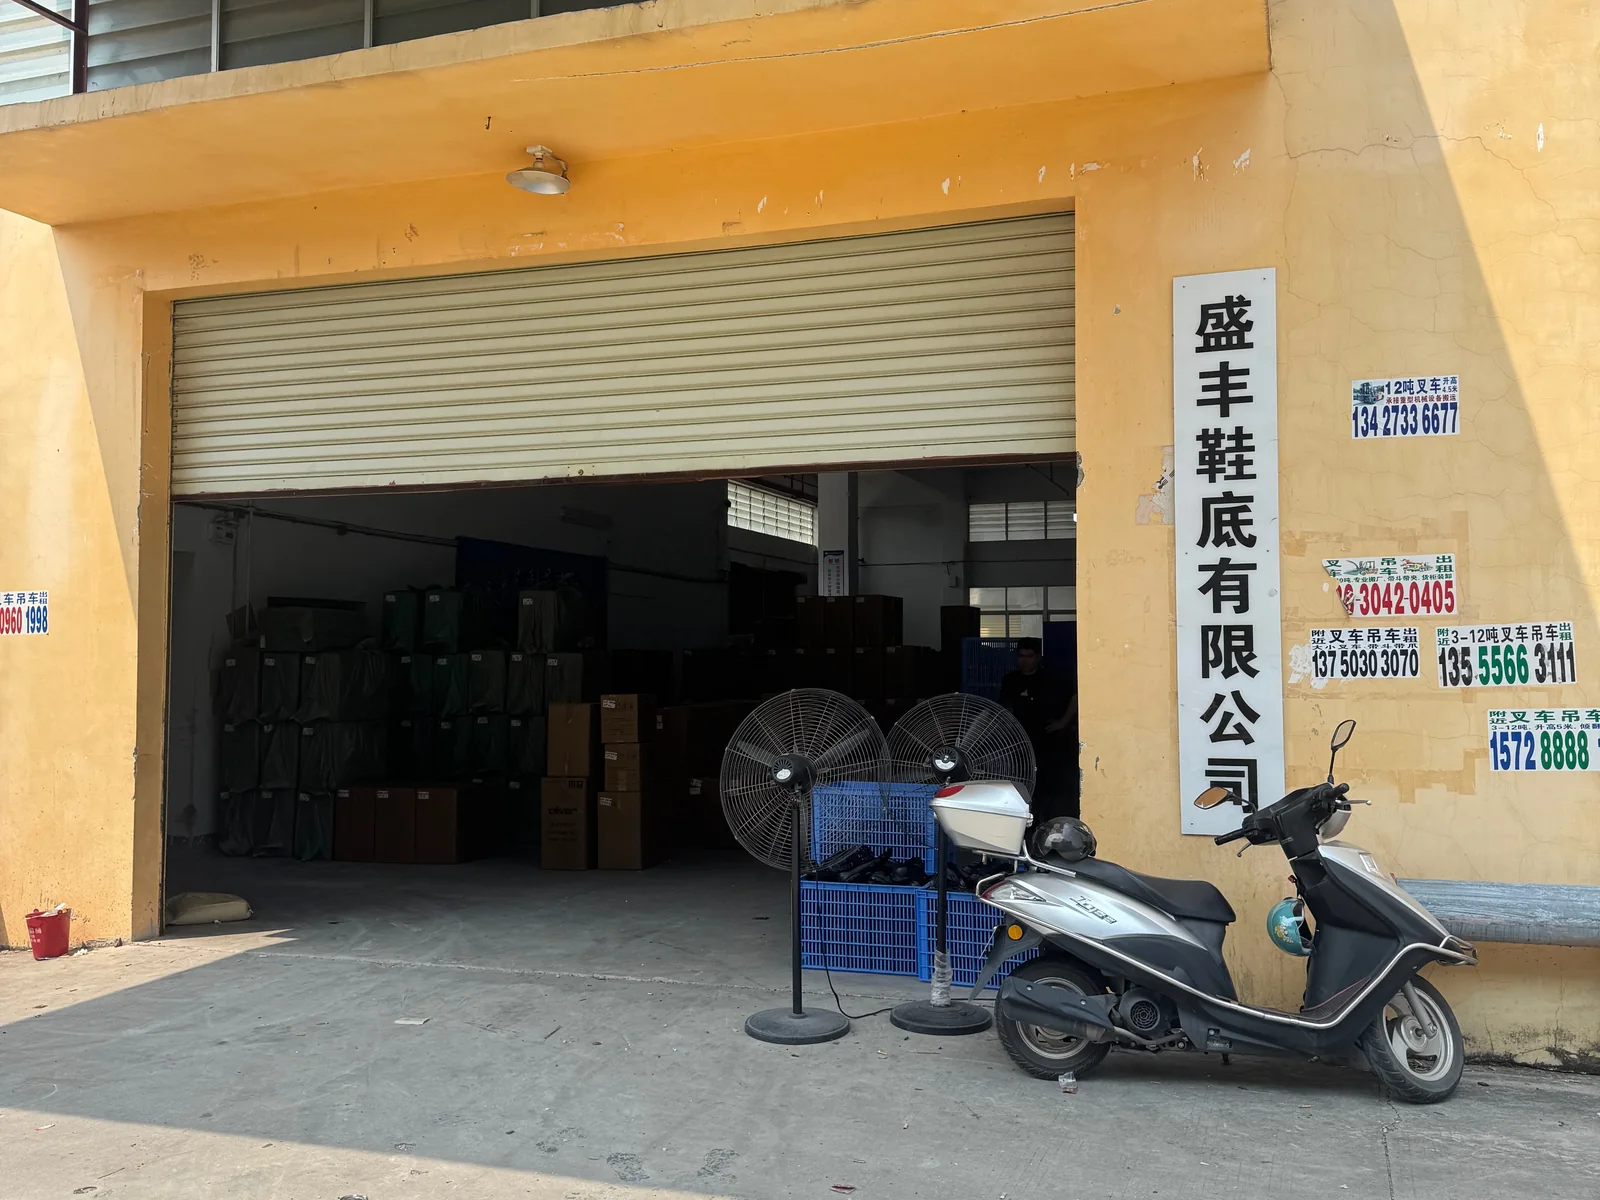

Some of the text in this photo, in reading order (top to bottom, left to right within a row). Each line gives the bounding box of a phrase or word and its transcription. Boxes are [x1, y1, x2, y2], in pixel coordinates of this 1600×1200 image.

[0, 592, 38, 605] 车吊车
[1196, 294, 1261, 813] 盛丰鞋底有限公司
